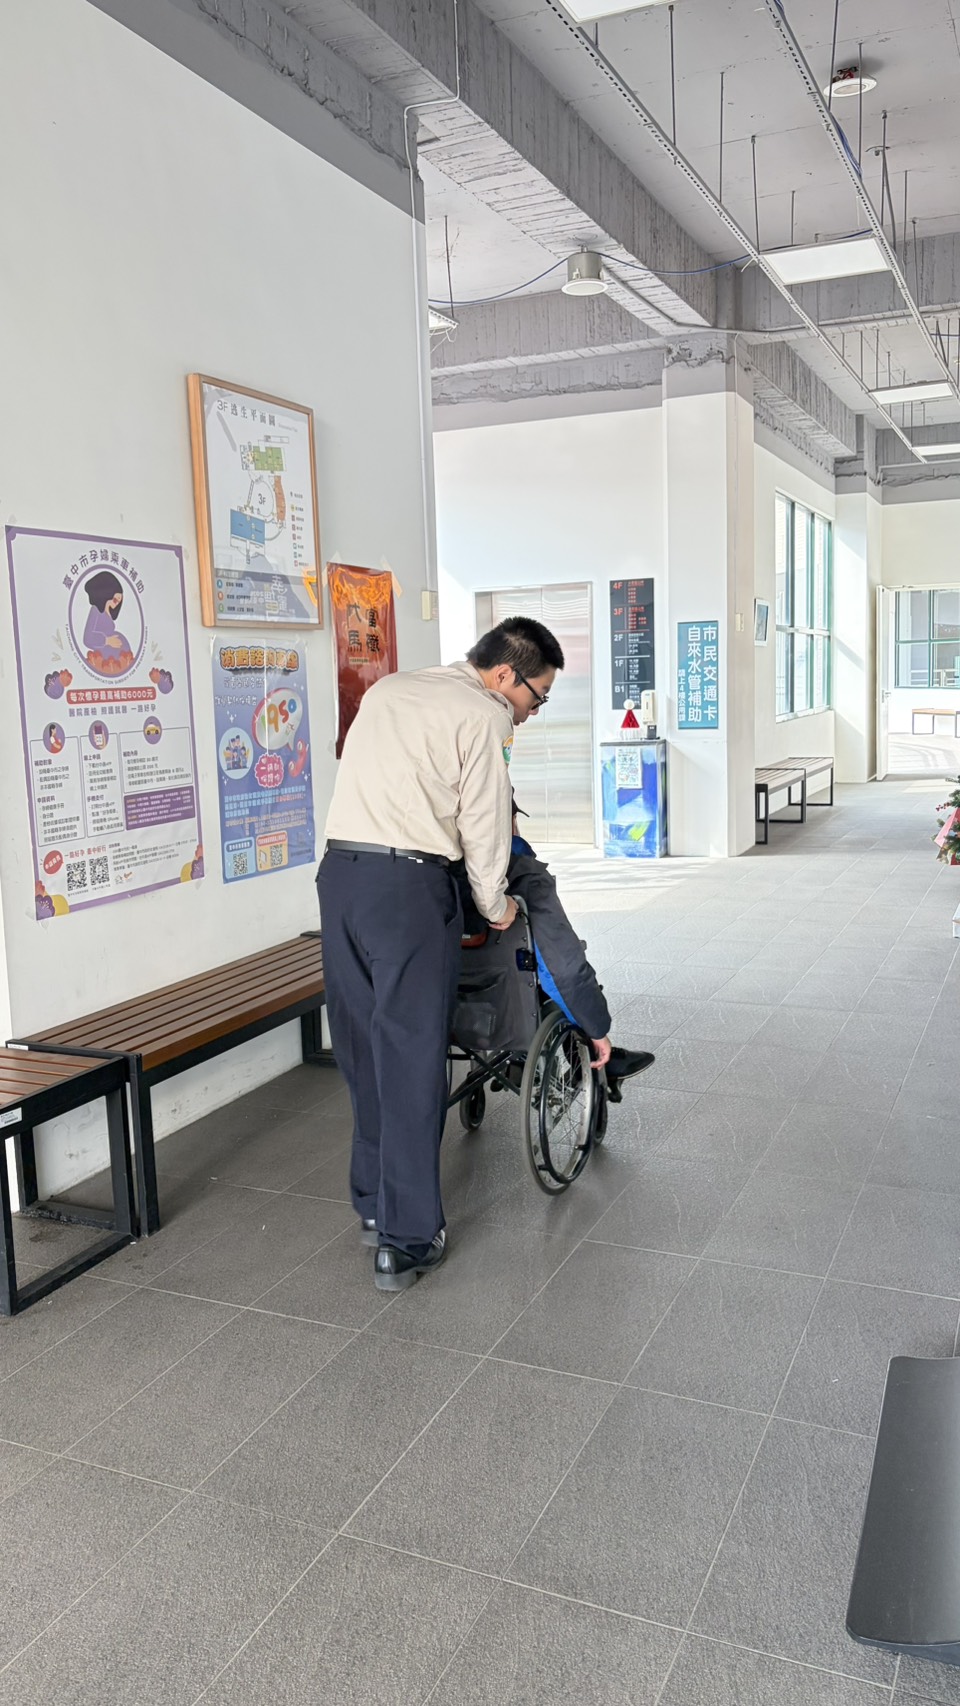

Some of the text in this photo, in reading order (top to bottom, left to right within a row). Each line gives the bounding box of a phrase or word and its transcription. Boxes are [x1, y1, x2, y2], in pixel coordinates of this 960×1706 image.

[217, 399, 228, 411] 3F
[231, 403, 276, 427] 逃生平面圖
[258, 493, 266, 505] 3F
[612, 581, 623, 590] 4F
[613, 607, 623, 616] 3F
[613, 634, 624, 642] 2F
[614, 659, 624, 667] 1F
[687, 625, 702, 722] 自來水管補助
[702, 624, 718, 721] 市民交通卡
[614, 685, 625, 693] B1
